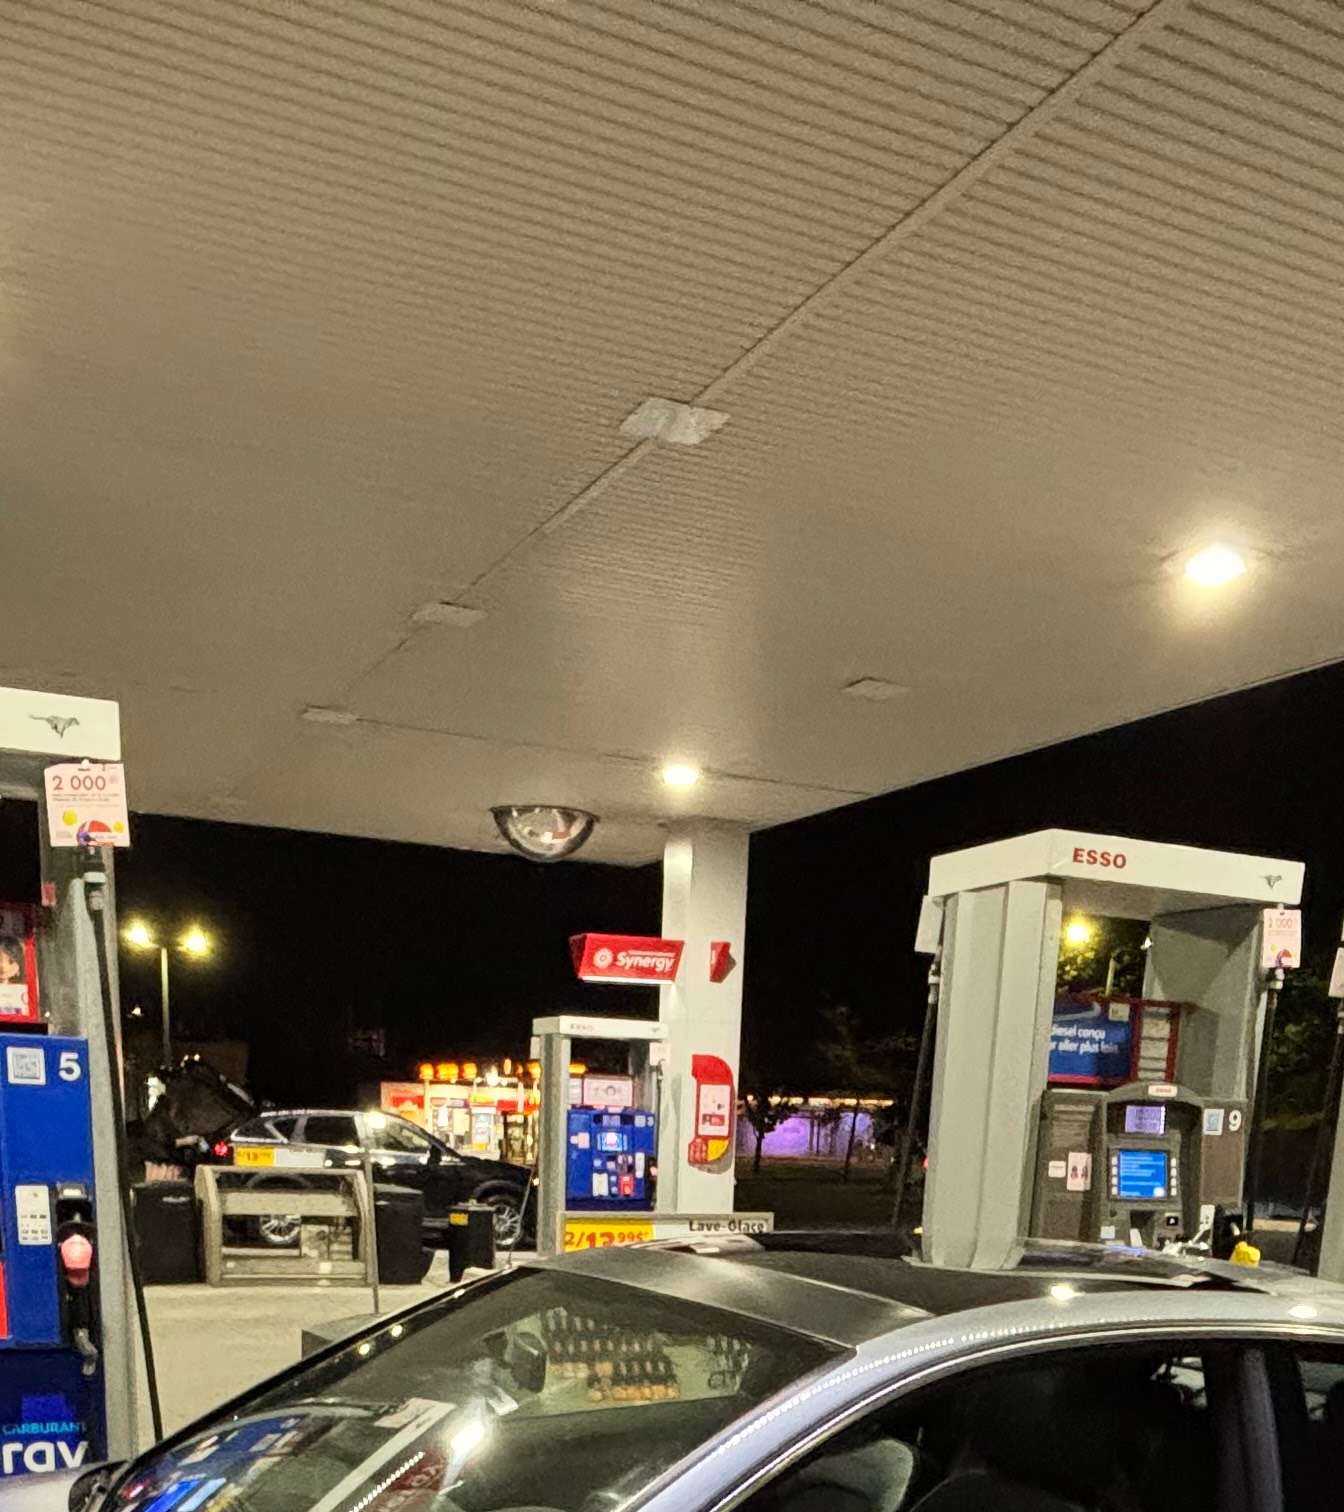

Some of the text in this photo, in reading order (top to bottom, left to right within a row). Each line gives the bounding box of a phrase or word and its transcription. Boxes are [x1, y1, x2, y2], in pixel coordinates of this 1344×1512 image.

[52, 775, 106, 791] 2 000
[1072, 847, 1127, 869] ESSO
[615, 951, 676, 973] Synergy
[58, 1052, 81, 1081] 5
[1228, 1110, 1242, 1132] 9
[2, 1421, 87, 1435] CARBURANT
